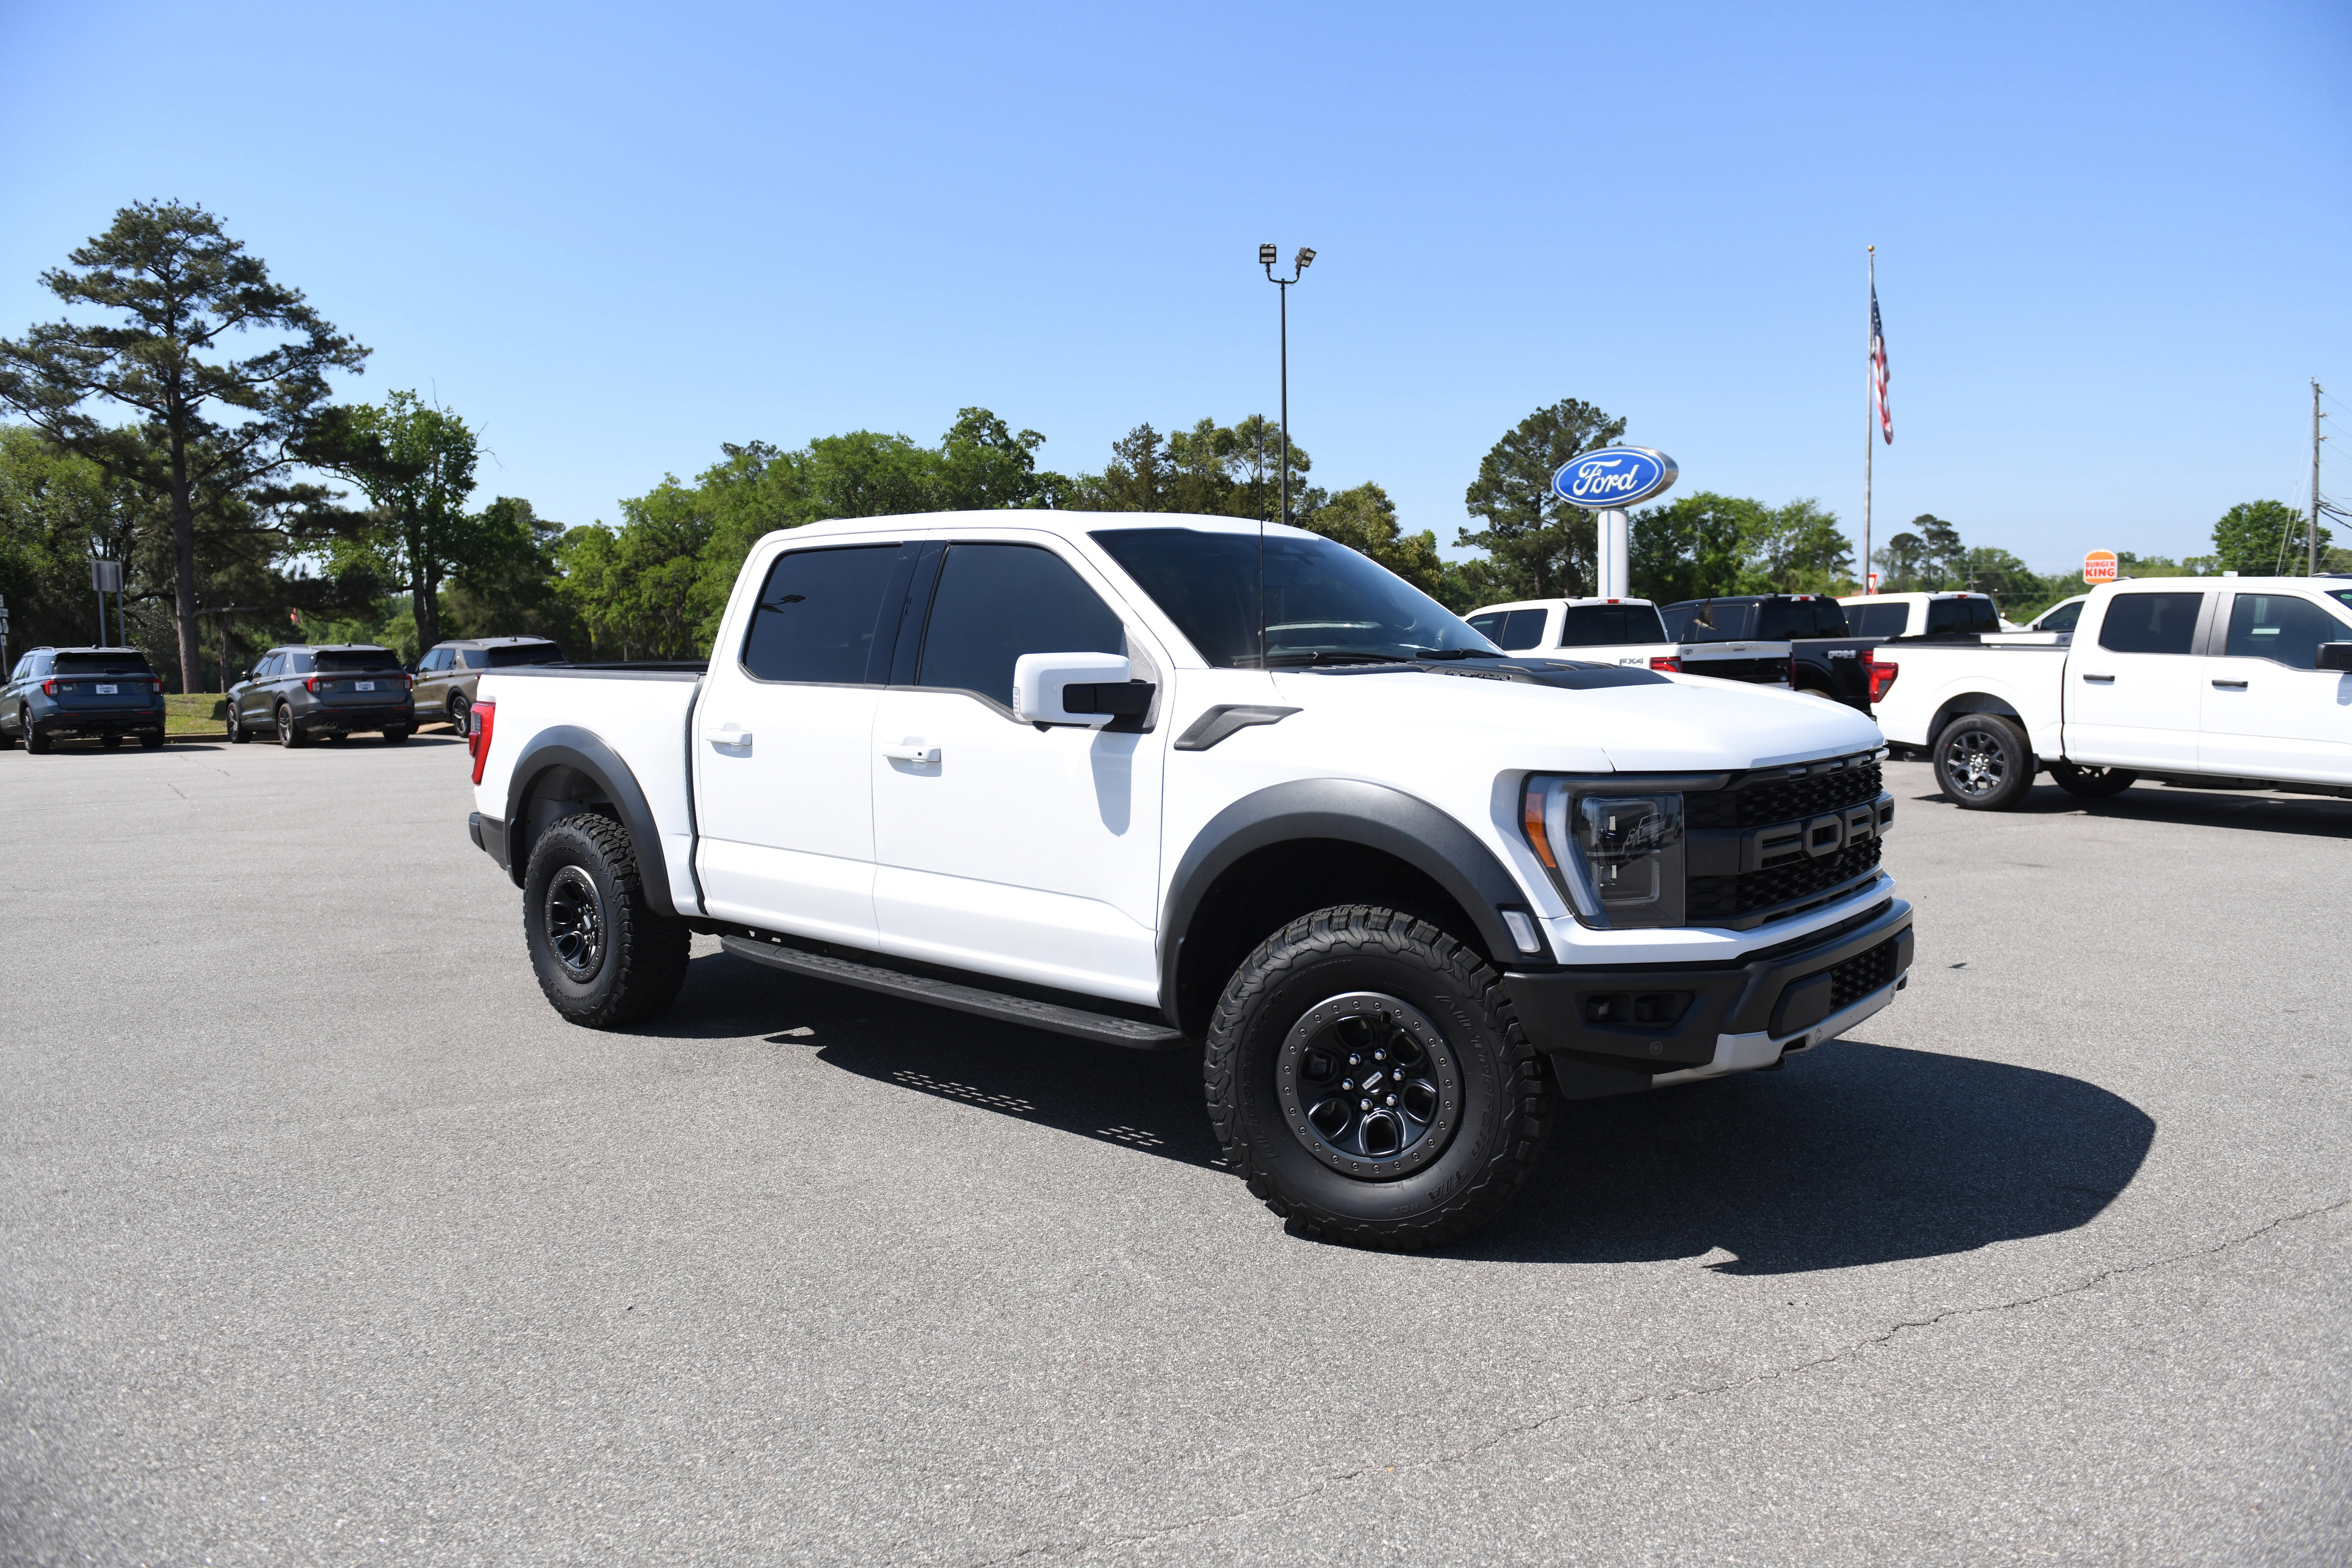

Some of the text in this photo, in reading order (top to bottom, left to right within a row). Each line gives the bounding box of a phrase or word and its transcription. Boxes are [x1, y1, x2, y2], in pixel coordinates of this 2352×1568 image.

[1572, 459, 1639, 496] Ford
[2085, 568, 2115, 577] KING
[1828, 650, 1856, 659] FX4
[1445, 668, 1510, 682] RAPTOR
[1743, 793, 1894, 872] FORD
[1365, 1074, 1379, 1087] FORD
[1434, 996, 1494, 1160] All-Terrain
[1425, 1167, 1468, 1203] T/A
[1390, 1202, 1419, 1215] KO2
